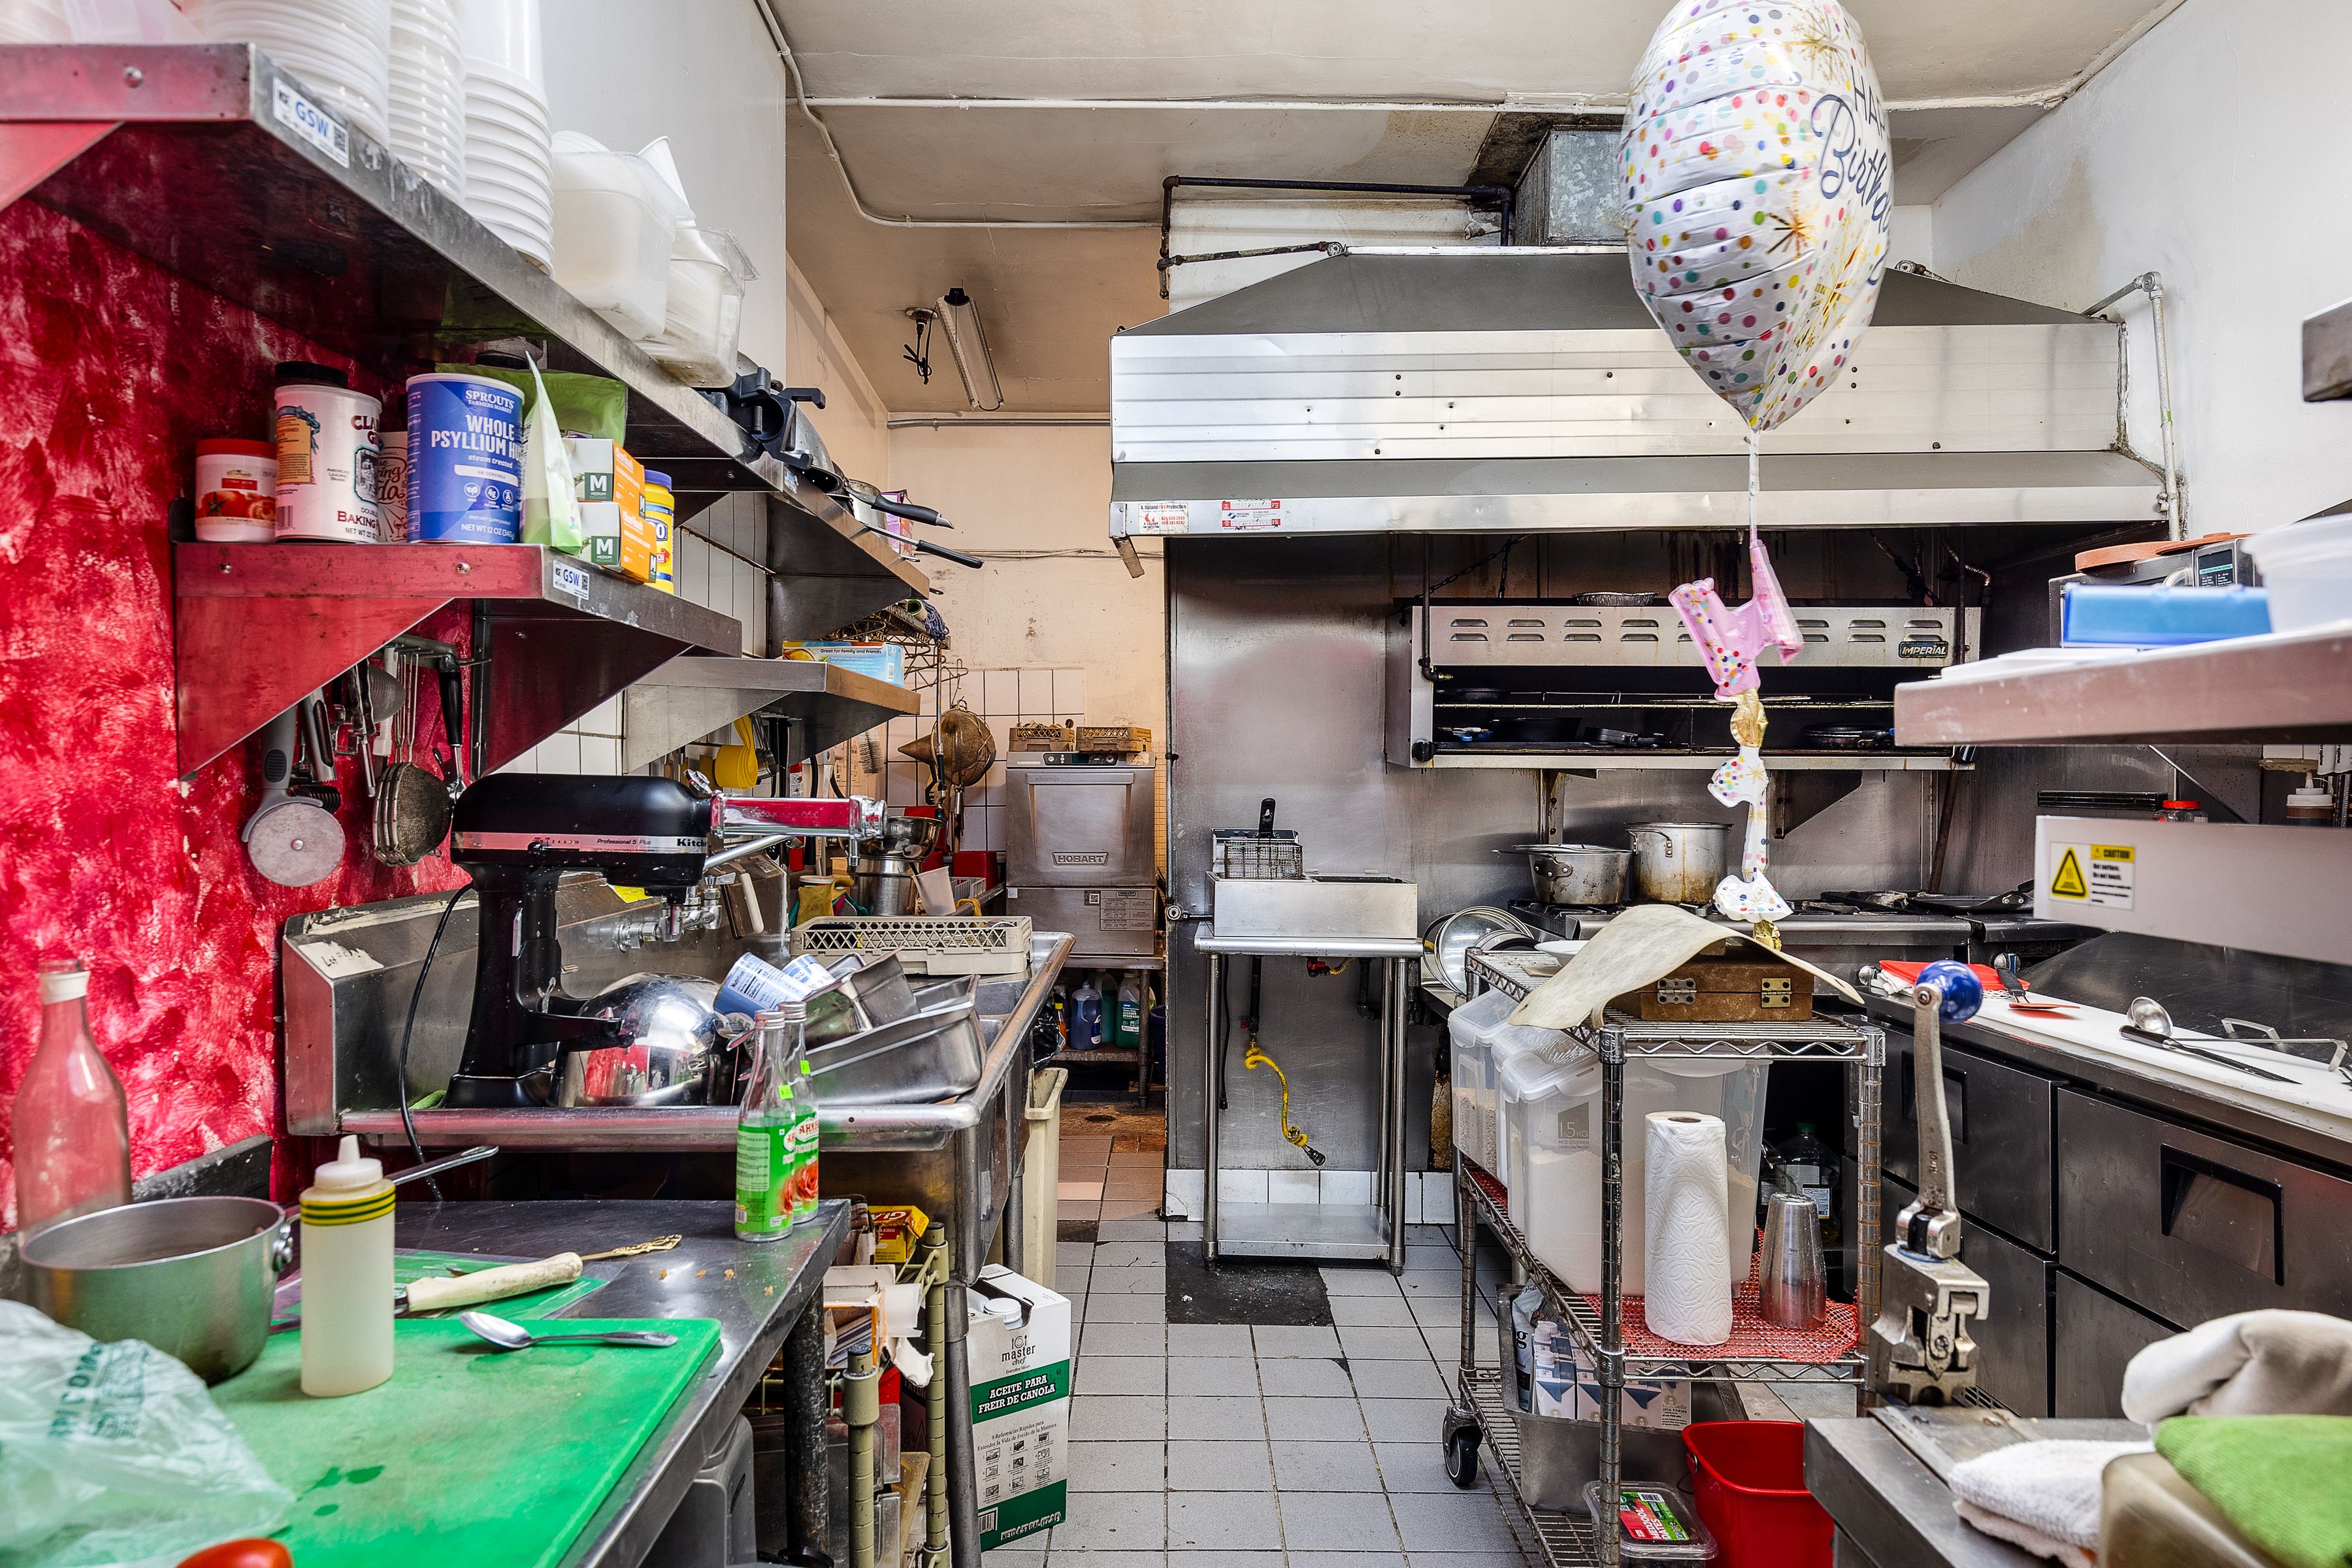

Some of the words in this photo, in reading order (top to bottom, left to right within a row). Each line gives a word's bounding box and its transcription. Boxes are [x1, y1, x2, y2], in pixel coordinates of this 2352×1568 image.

[295, 101, 329, 137] GSW
[465, 390, 515, 410] SPROUTS
[468, 400, 494, 410] FARMERS
[494, 404, 512, 414] MARKET
[465, 415, 515, 442] WHOLE
[431, 431, 506, 456] PSYLLIUM
[468, 455, 491, 464] steam
[492, 458, 514, 469] treated
[589, 474, 608, 492] M
[337, 511, 376, 528] BAKING
[596, 538, 613, 555] M
[563, 569, 580, 586] GSW
[677, 838, 707, 847] Kitch
[2104, 849, 2130, 859] CAUTION
[731, 971, 745, 988] Nutrition
[871, 1211, 906, 1220] GLA
[1002, 1345, 1036, 1362] master
[1012, 1357, 1027, 1365] chef
[990, 1382, 1022, 1399] ACEITE
[1025, 1375, 1047, 1389] PARA
[978, 1399, 1006, 1414] FREIR
[1007, 1396, 1019, 1405] DE
[1020, 1384, 1056, 1401] CANOLA
[977, 1442, 996, 1451] Extender
[1041, 1423, 1056, 1431] Manteca
[995, 1429, 1019, 1439] Referencias
[1019, 1423, 1035, 1433] Rápidas
[1635, 1507, 1662, 1539] MEDJOOL
[1650, 1518, 1671, 1539] DATES
[1001, 1528, 1017, 1541] NETO
